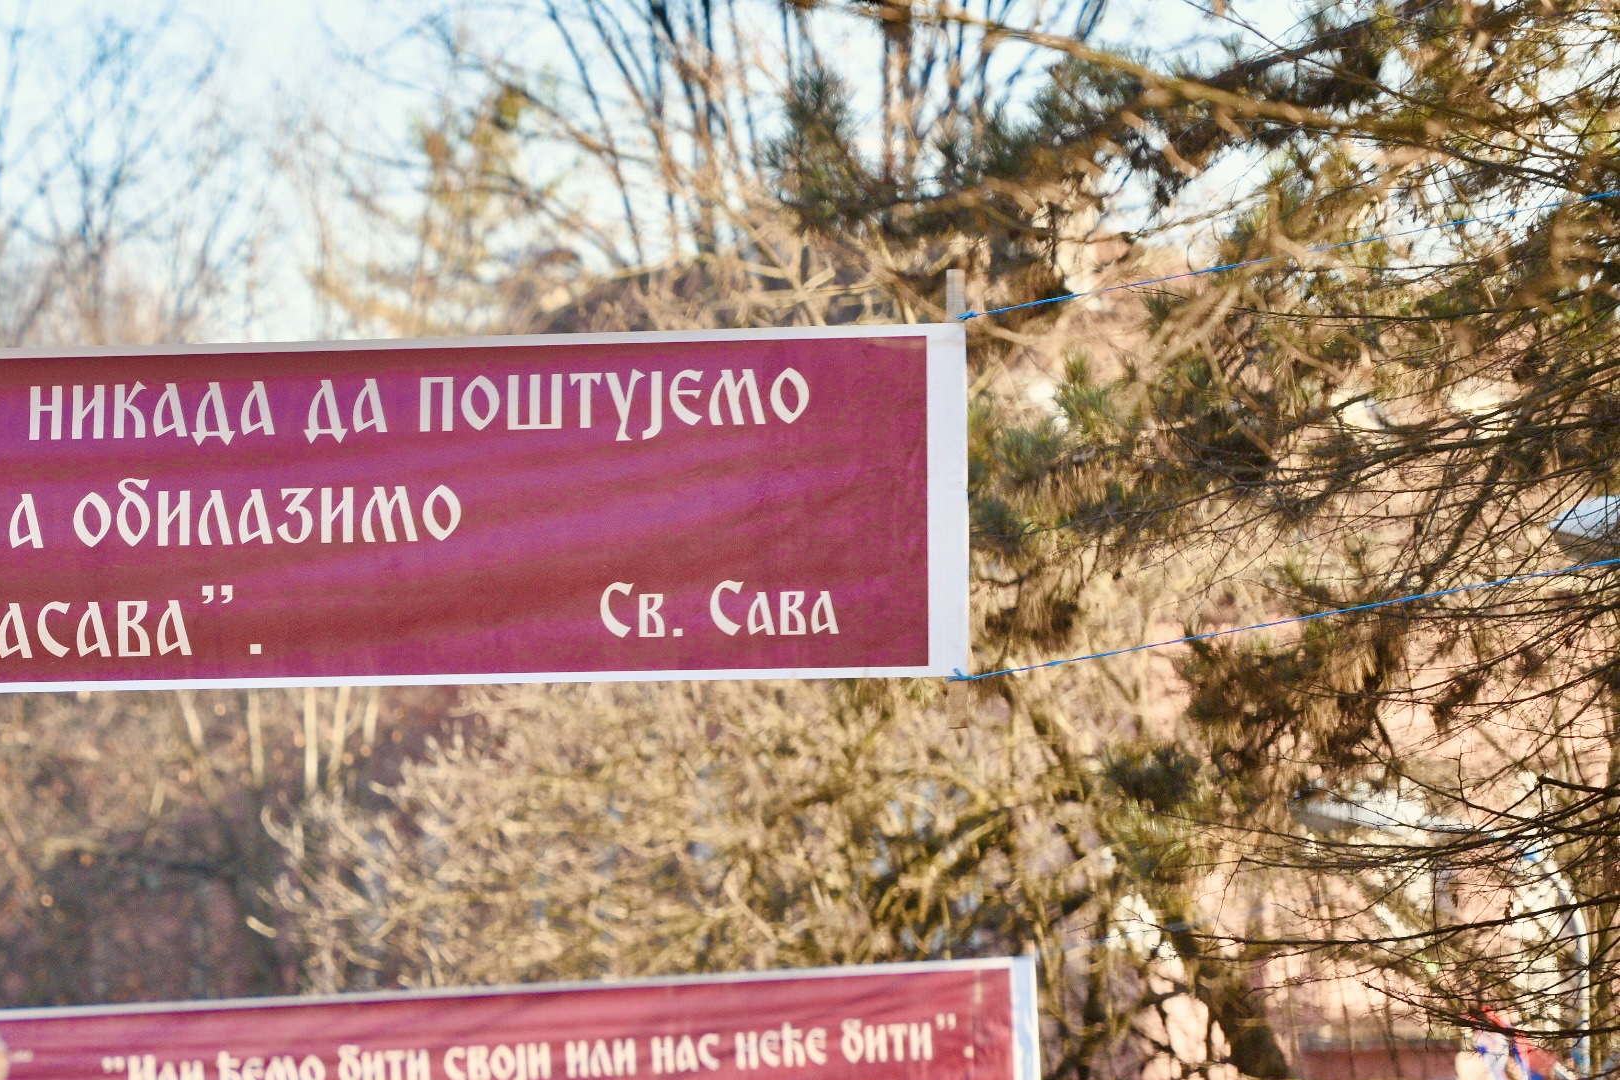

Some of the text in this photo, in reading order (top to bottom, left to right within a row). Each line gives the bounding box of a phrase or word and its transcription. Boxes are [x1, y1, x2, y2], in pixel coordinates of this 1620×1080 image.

[29, 381, 275, 446] никада
[303, 378, 388, 444] да
[8, 493, 44, 549] а
[72, 477, 462, 548] обилазимо
[709, 579, 839, 636] Сава
